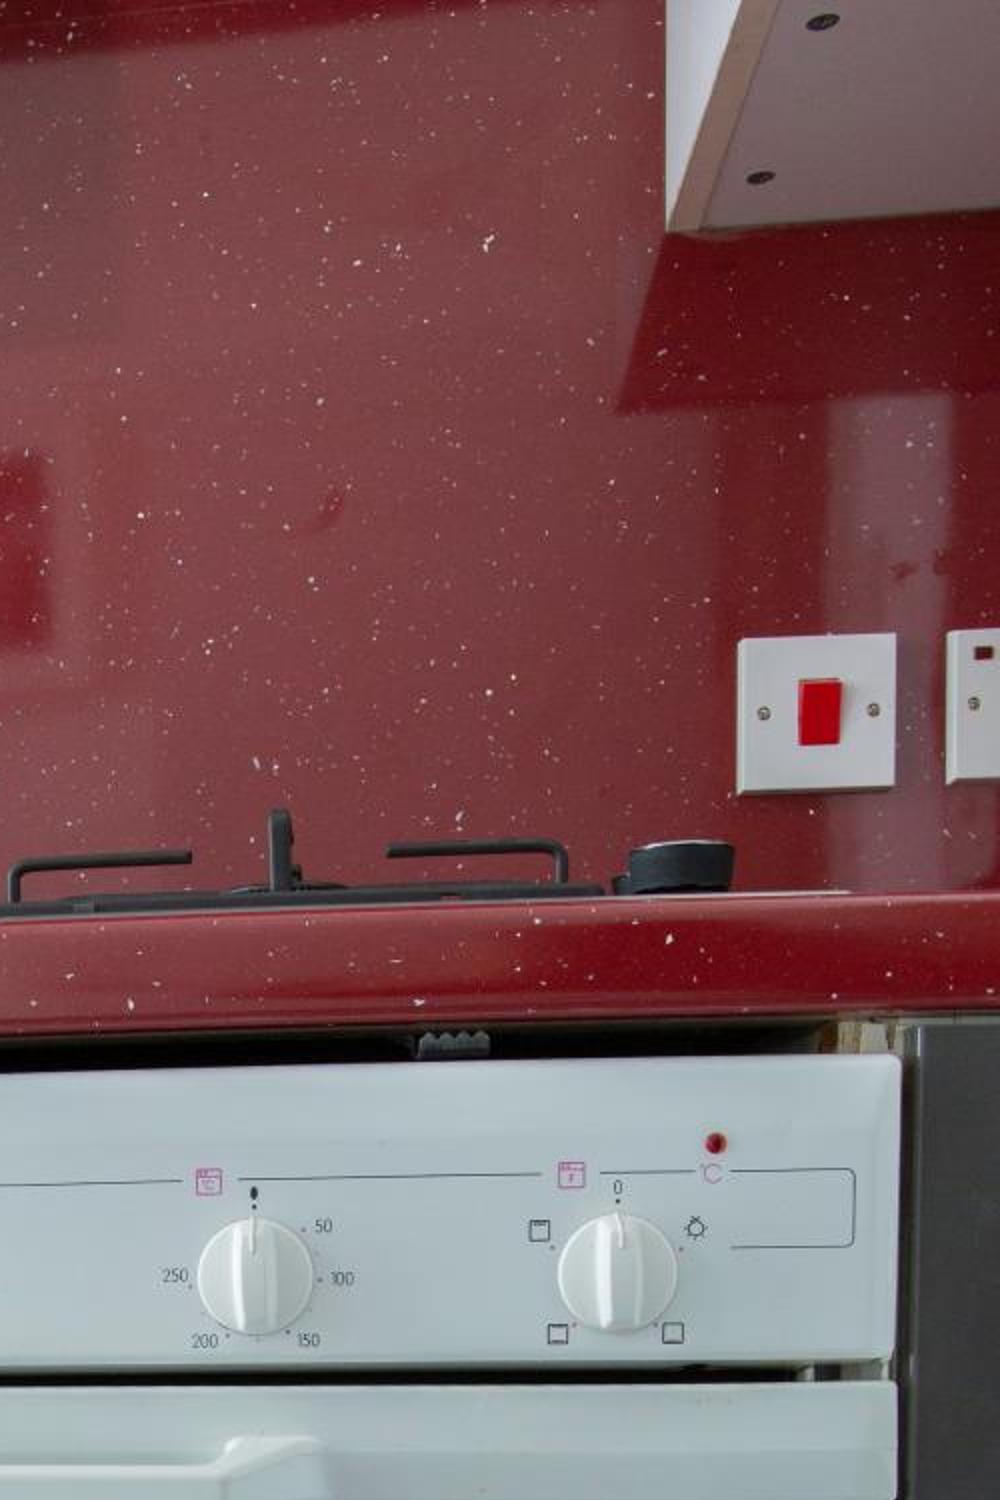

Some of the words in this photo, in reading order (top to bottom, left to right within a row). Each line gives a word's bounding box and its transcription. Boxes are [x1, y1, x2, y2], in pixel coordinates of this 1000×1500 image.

[314, 1218, 333, 1234] 50
[162, 1267, 189, 1284] 250
[330, 1270, 356, 1287] 100
[191, 1333, 219, 1350] 200
[297, 1332, 321, 1349] 150
